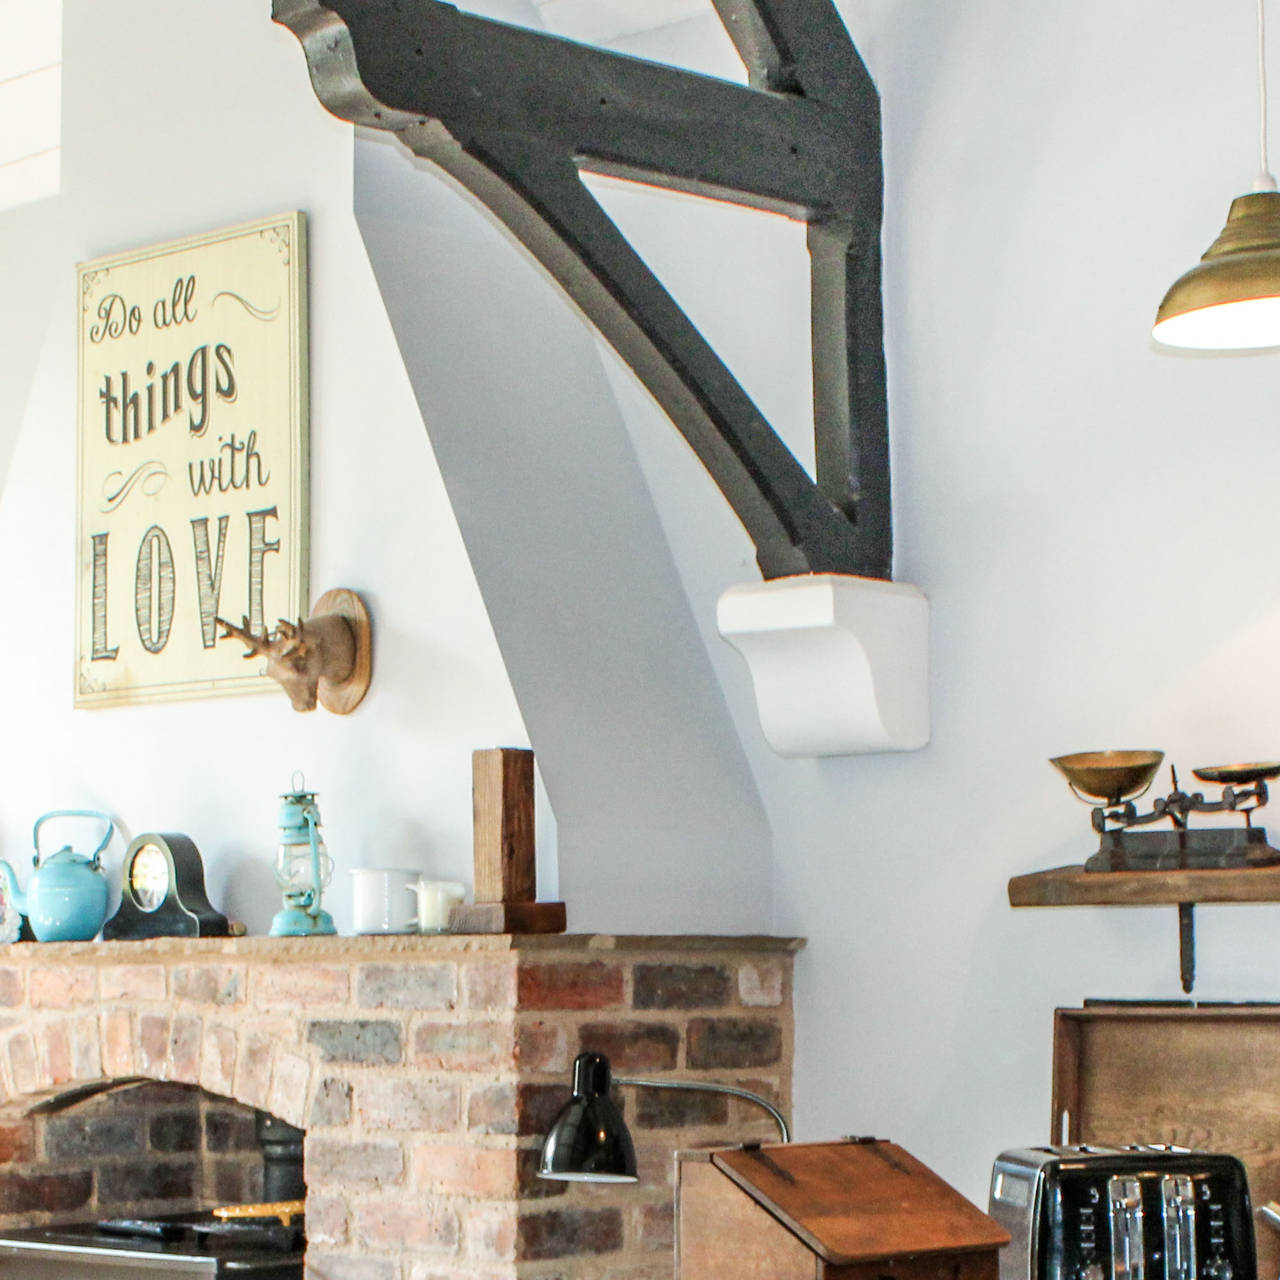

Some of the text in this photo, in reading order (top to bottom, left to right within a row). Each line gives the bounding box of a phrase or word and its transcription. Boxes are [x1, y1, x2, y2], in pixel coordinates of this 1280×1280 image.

[90, 274, 198, 343] Do all
[99, 342, 237, 445] things
[188, 430, 270, 497] with
[91, 506, 281, 662] LOVE
